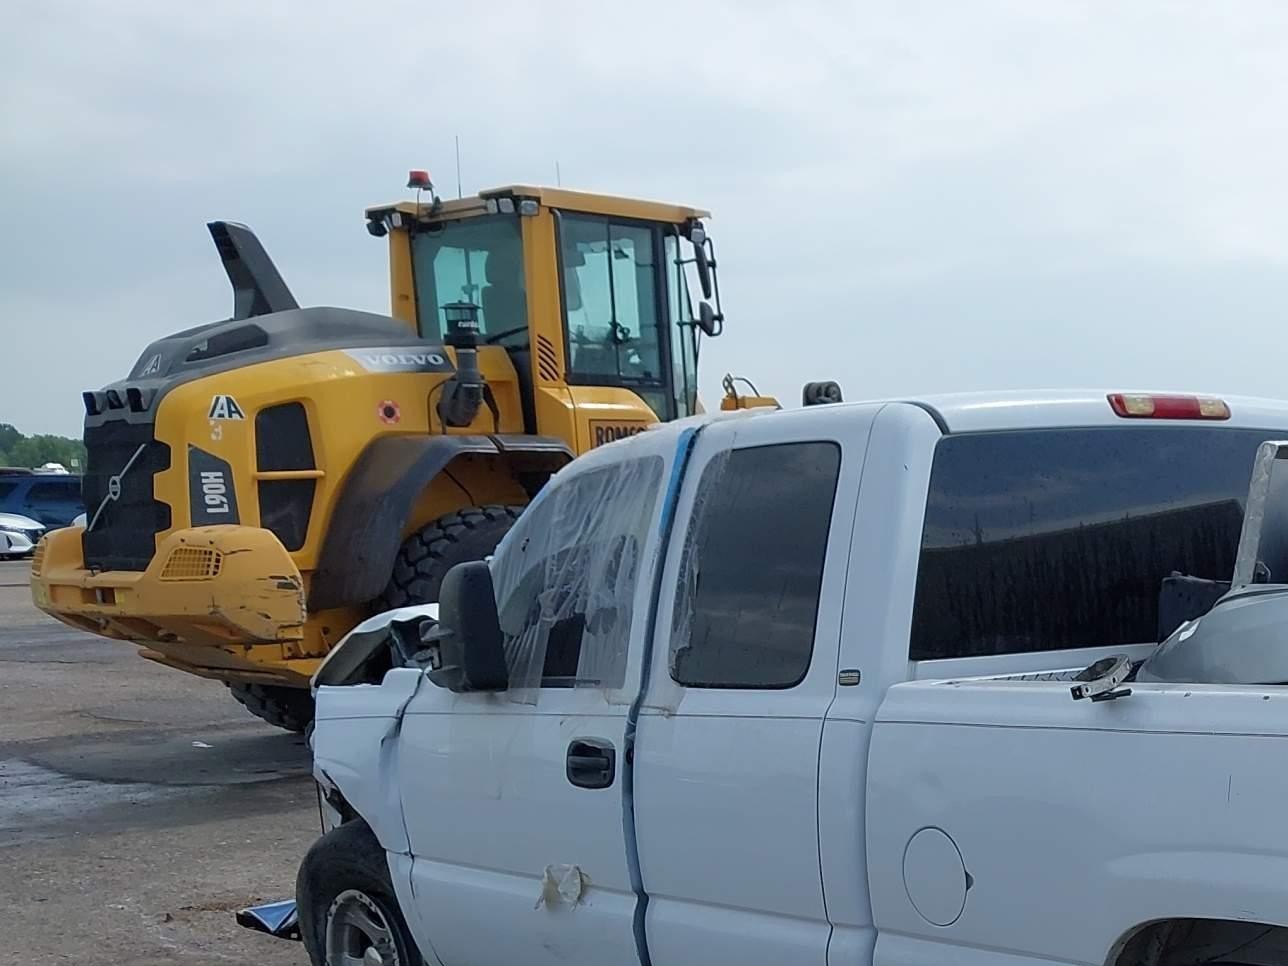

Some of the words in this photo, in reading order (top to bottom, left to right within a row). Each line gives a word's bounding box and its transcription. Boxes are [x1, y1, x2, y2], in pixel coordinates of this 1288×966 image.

[365, 352, 445, 366] VOLVO
[595, 426, 647, 447] ROM
[200, 471, 229, 514] L90H
